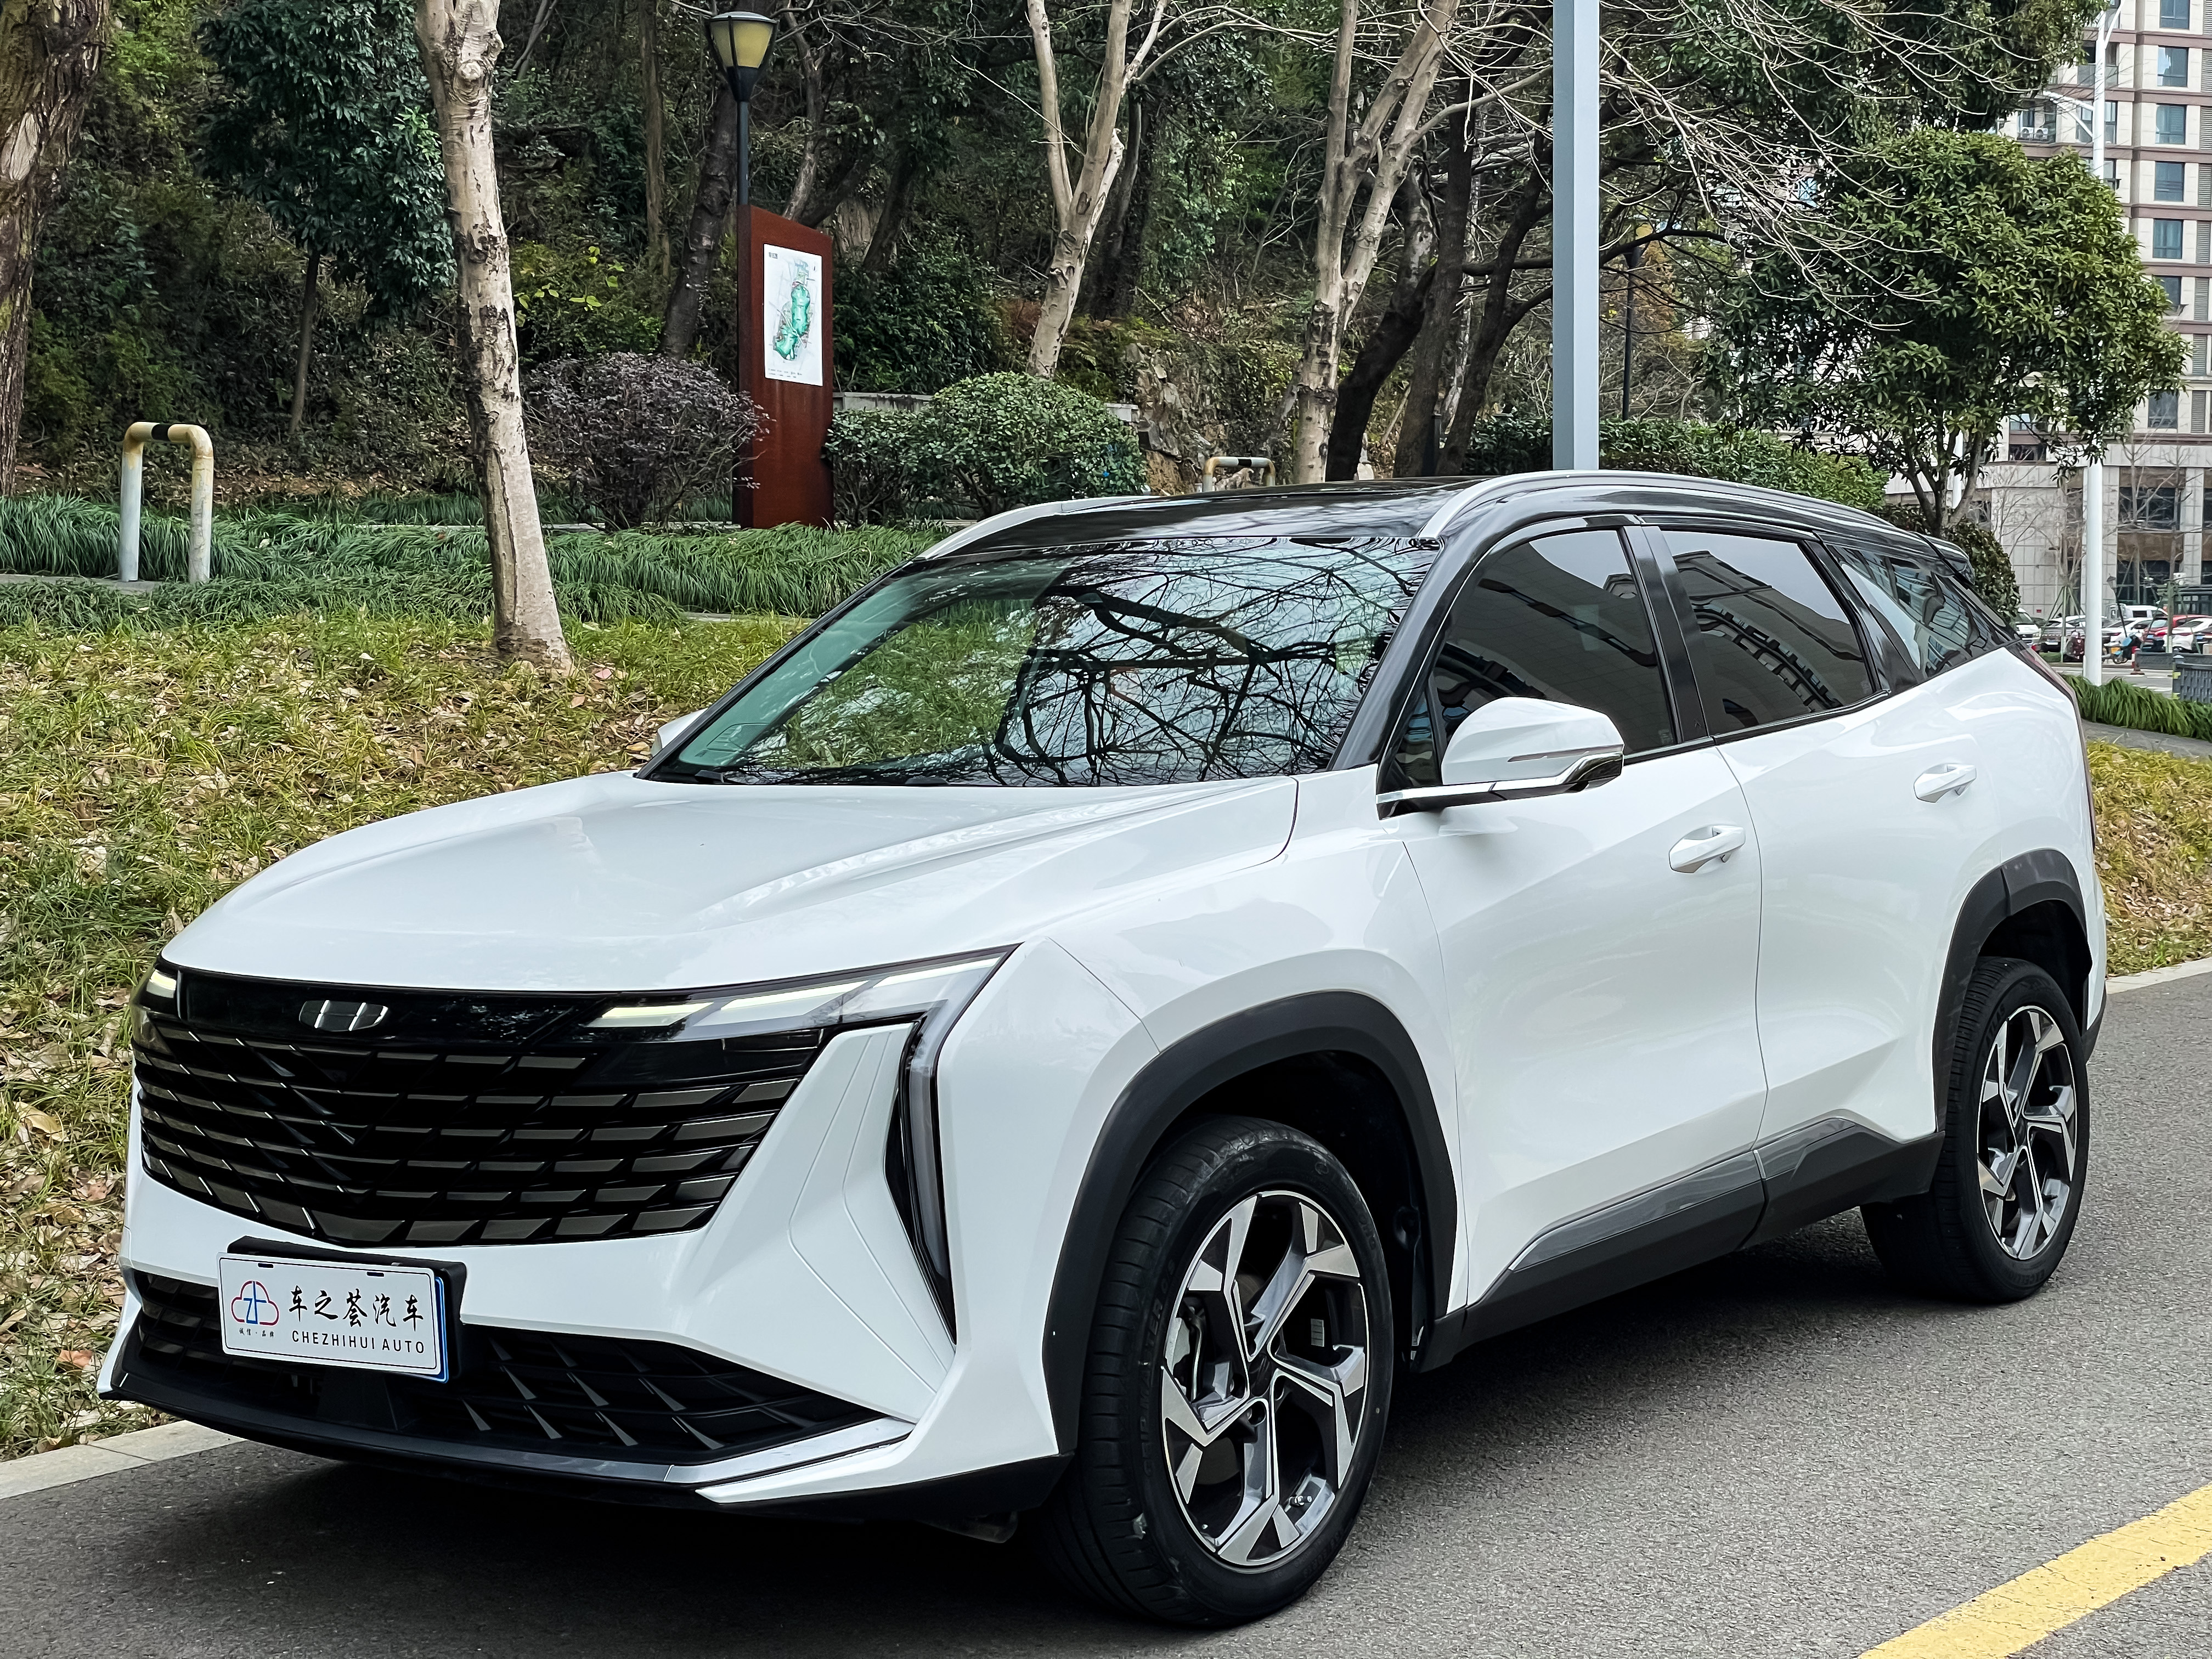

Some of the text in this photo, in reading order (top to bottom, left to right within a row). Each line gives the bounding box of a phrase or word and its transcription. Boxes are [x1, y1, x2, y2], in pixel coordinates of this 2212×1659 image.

[288, 1285, 425, 1333] 车之荟汽车
[291, 1330, 425, 1354] CHEZHIHUI AUTO
[1139, 1297, 1164, 1409] MATER
